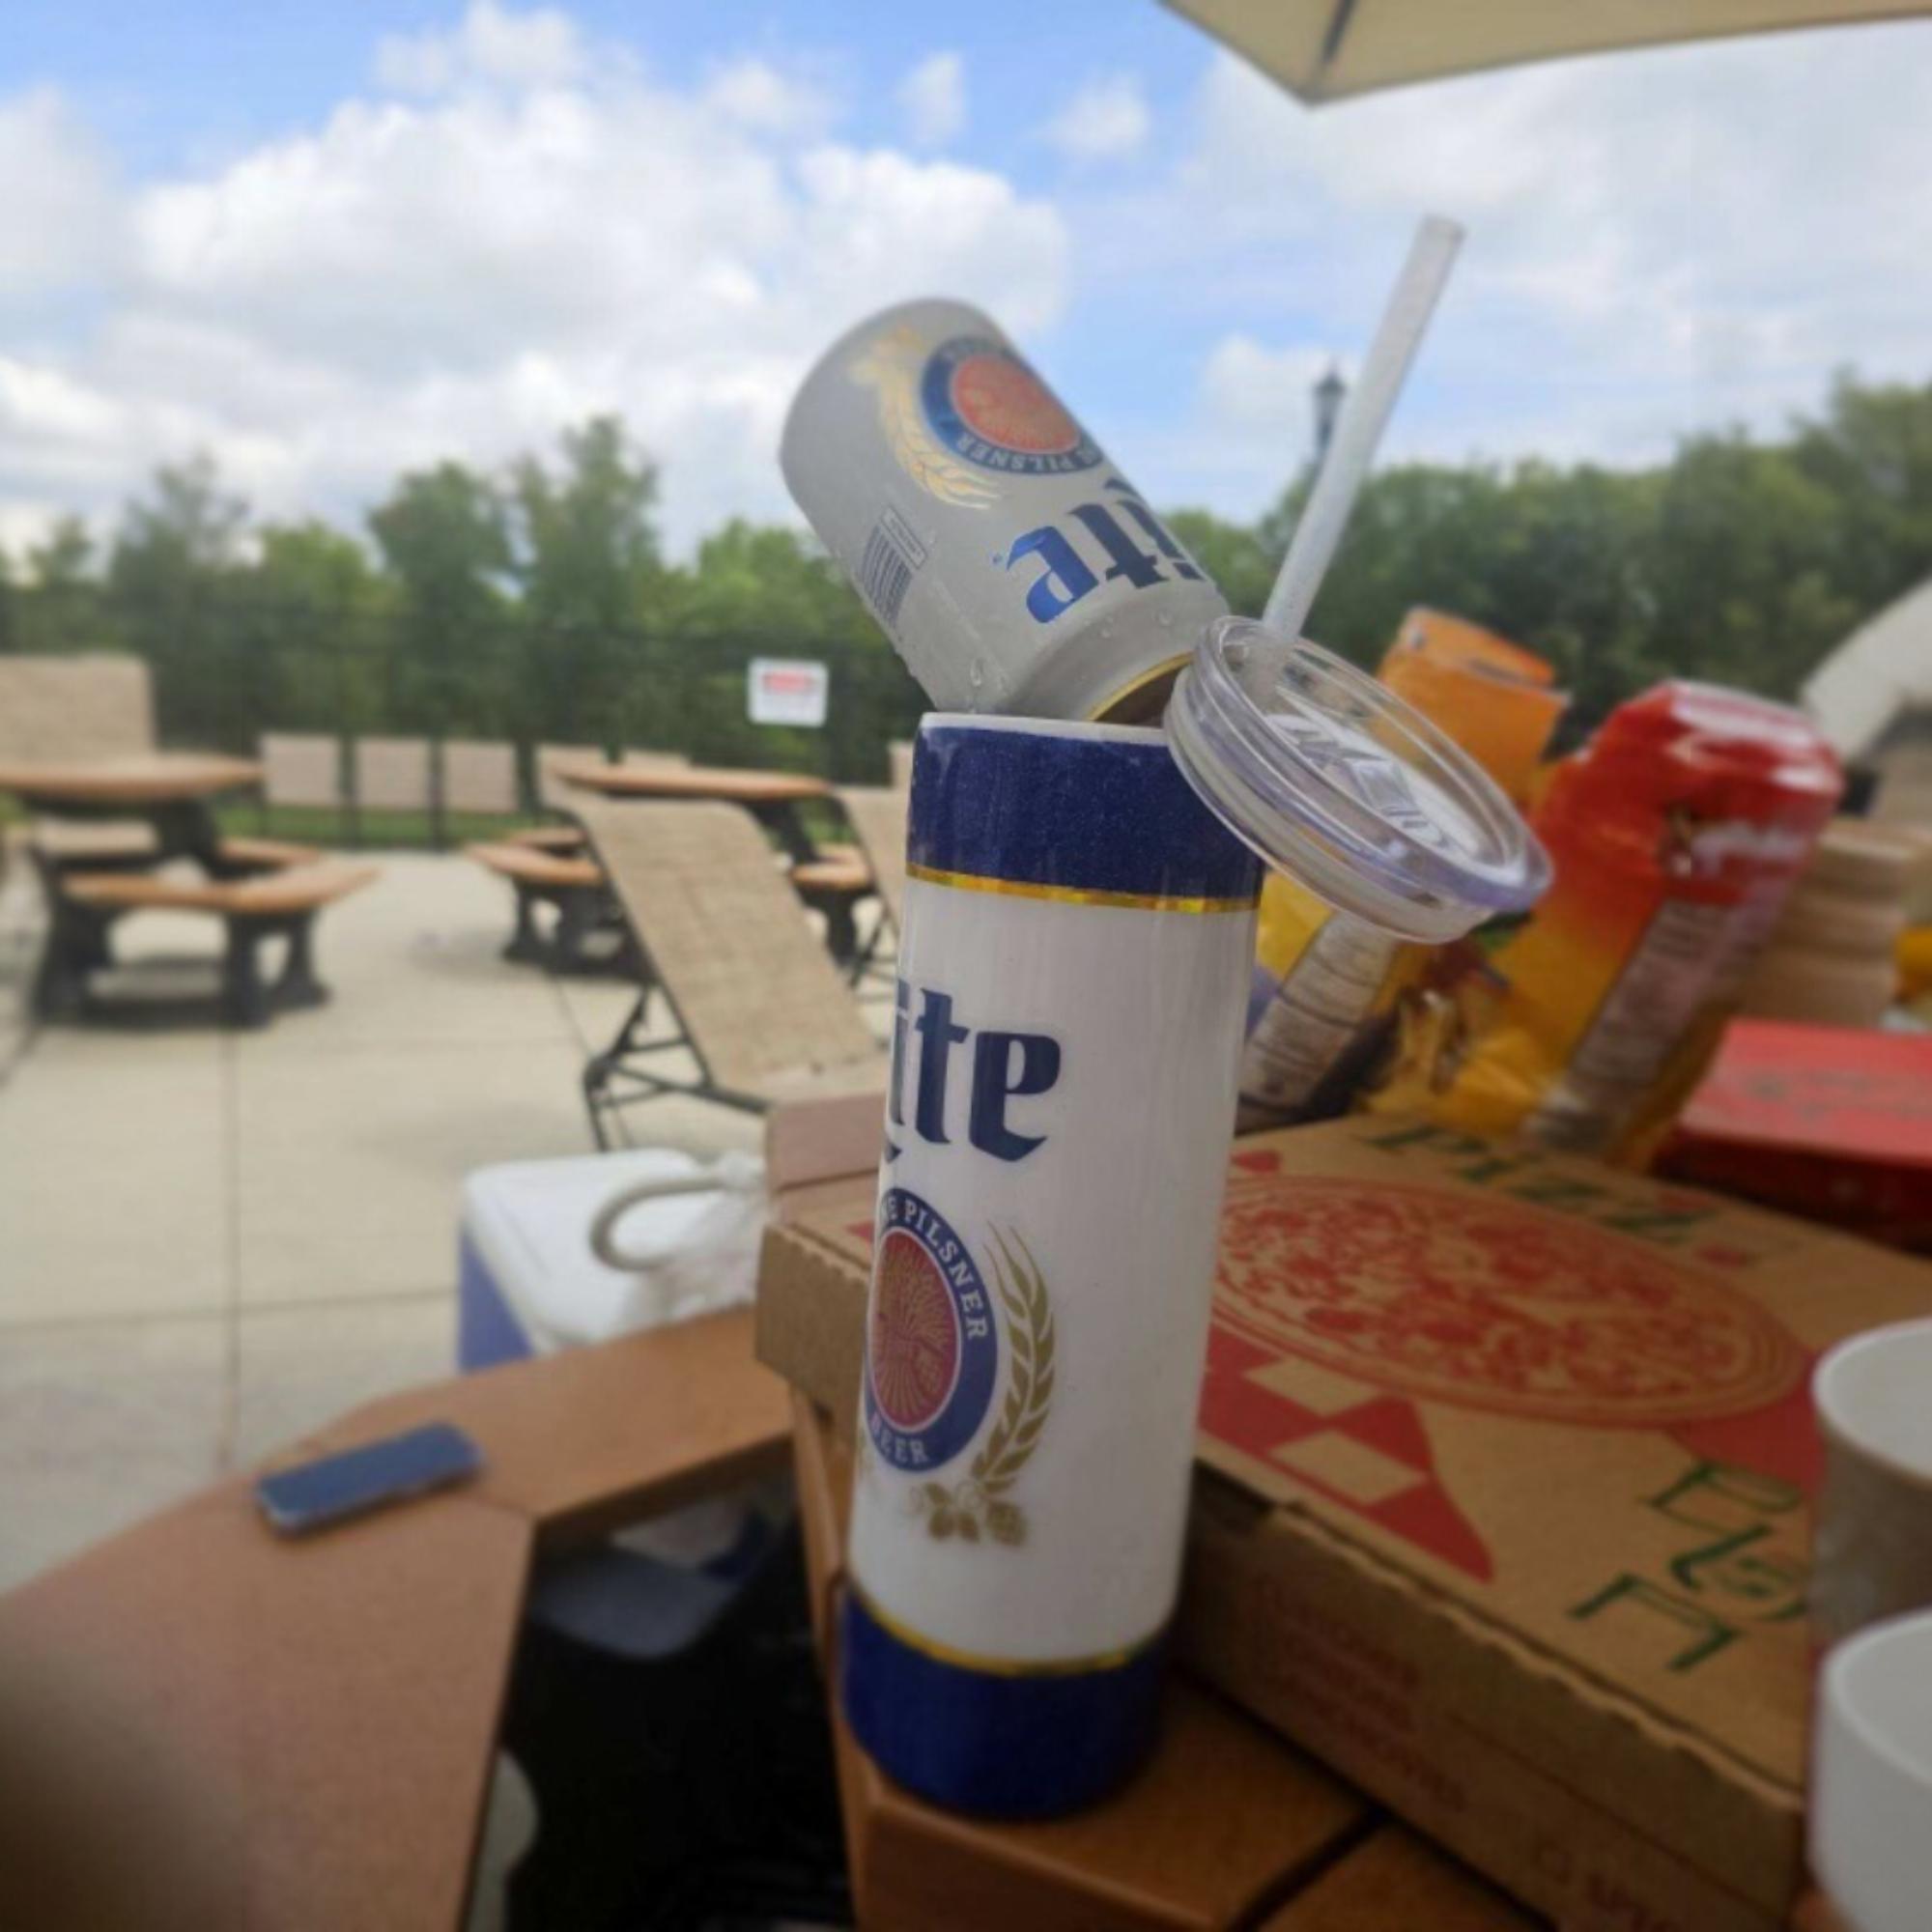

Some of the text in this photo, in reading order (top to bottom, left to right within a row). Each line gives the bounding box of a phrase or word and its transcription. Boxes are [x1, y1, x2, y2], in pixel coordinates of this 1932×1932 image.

[955, 431, 1078, 471] PILSNER
[1006, 477, 1207, 624] ite
[884, 978, 1062, 1163] ite
[904, 1198, 987, 1340] PILSNER
[870, 1411, 929, 1464] BEER
